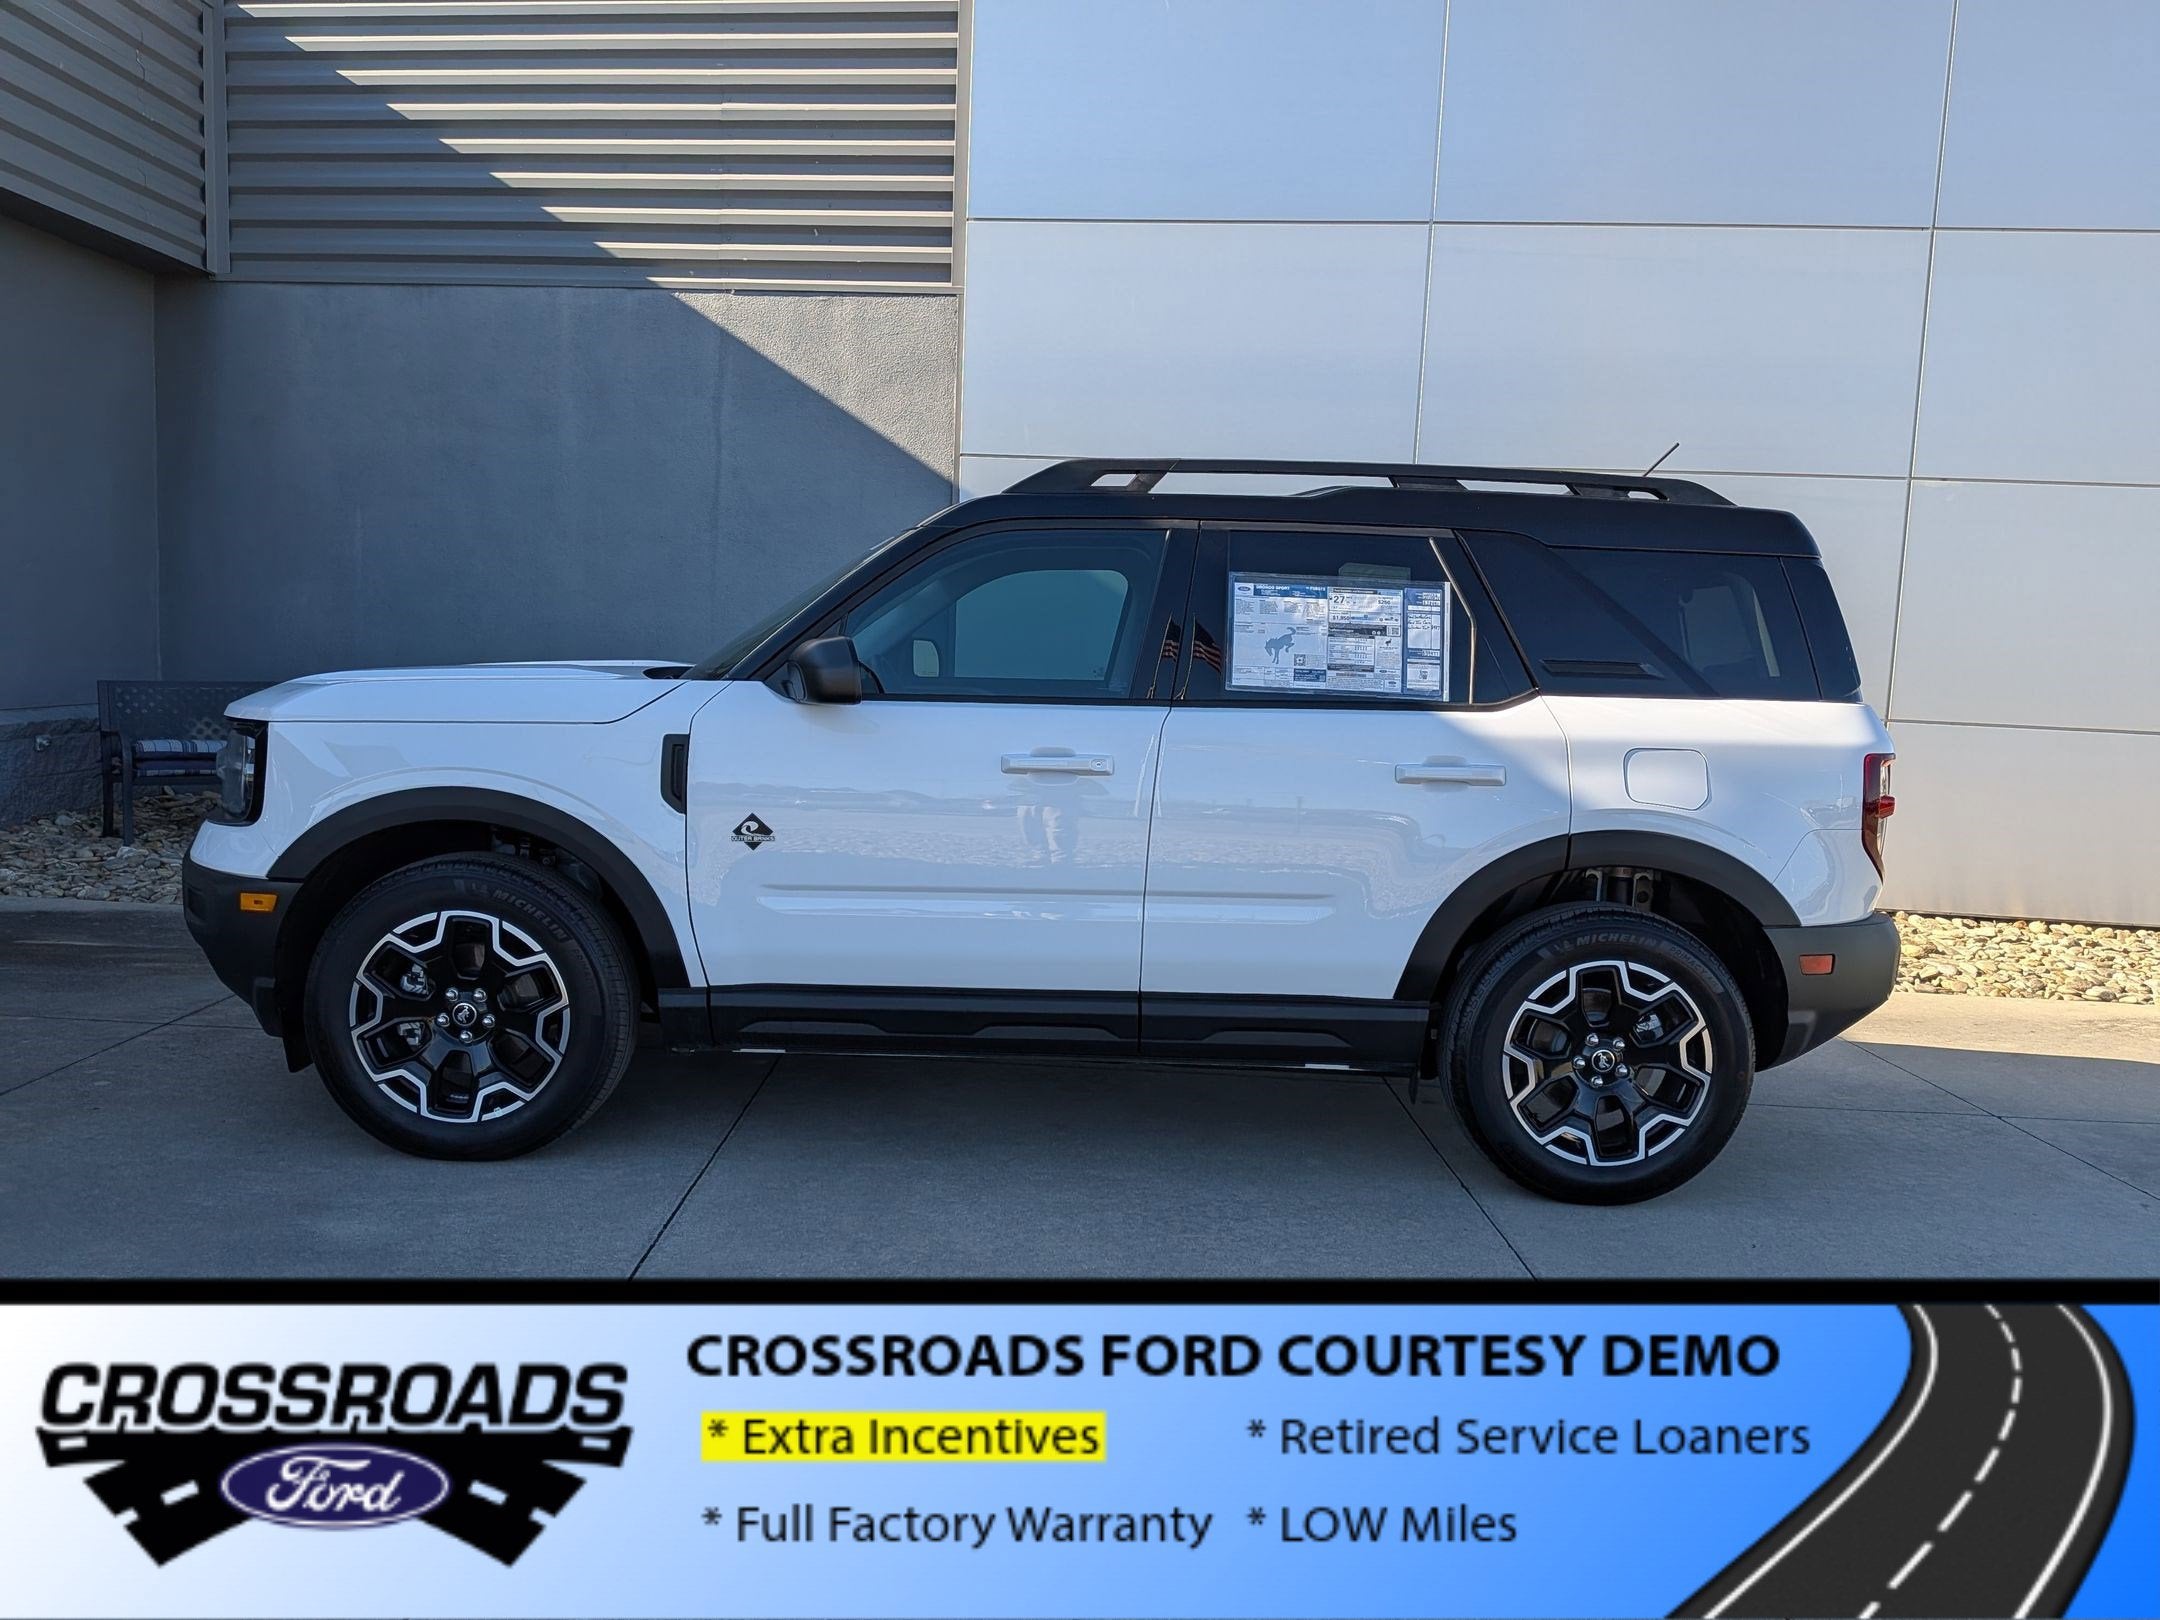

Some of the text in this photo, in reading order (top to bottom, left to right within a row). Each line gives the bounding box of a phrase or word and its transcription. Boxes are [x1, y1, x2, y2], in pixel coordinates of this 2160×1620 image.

[1333, 595, 1345, 604] 27
[492, 887, 571, 943] MICHELIN
[1576, 932, 1658, 947] MICHELIN
